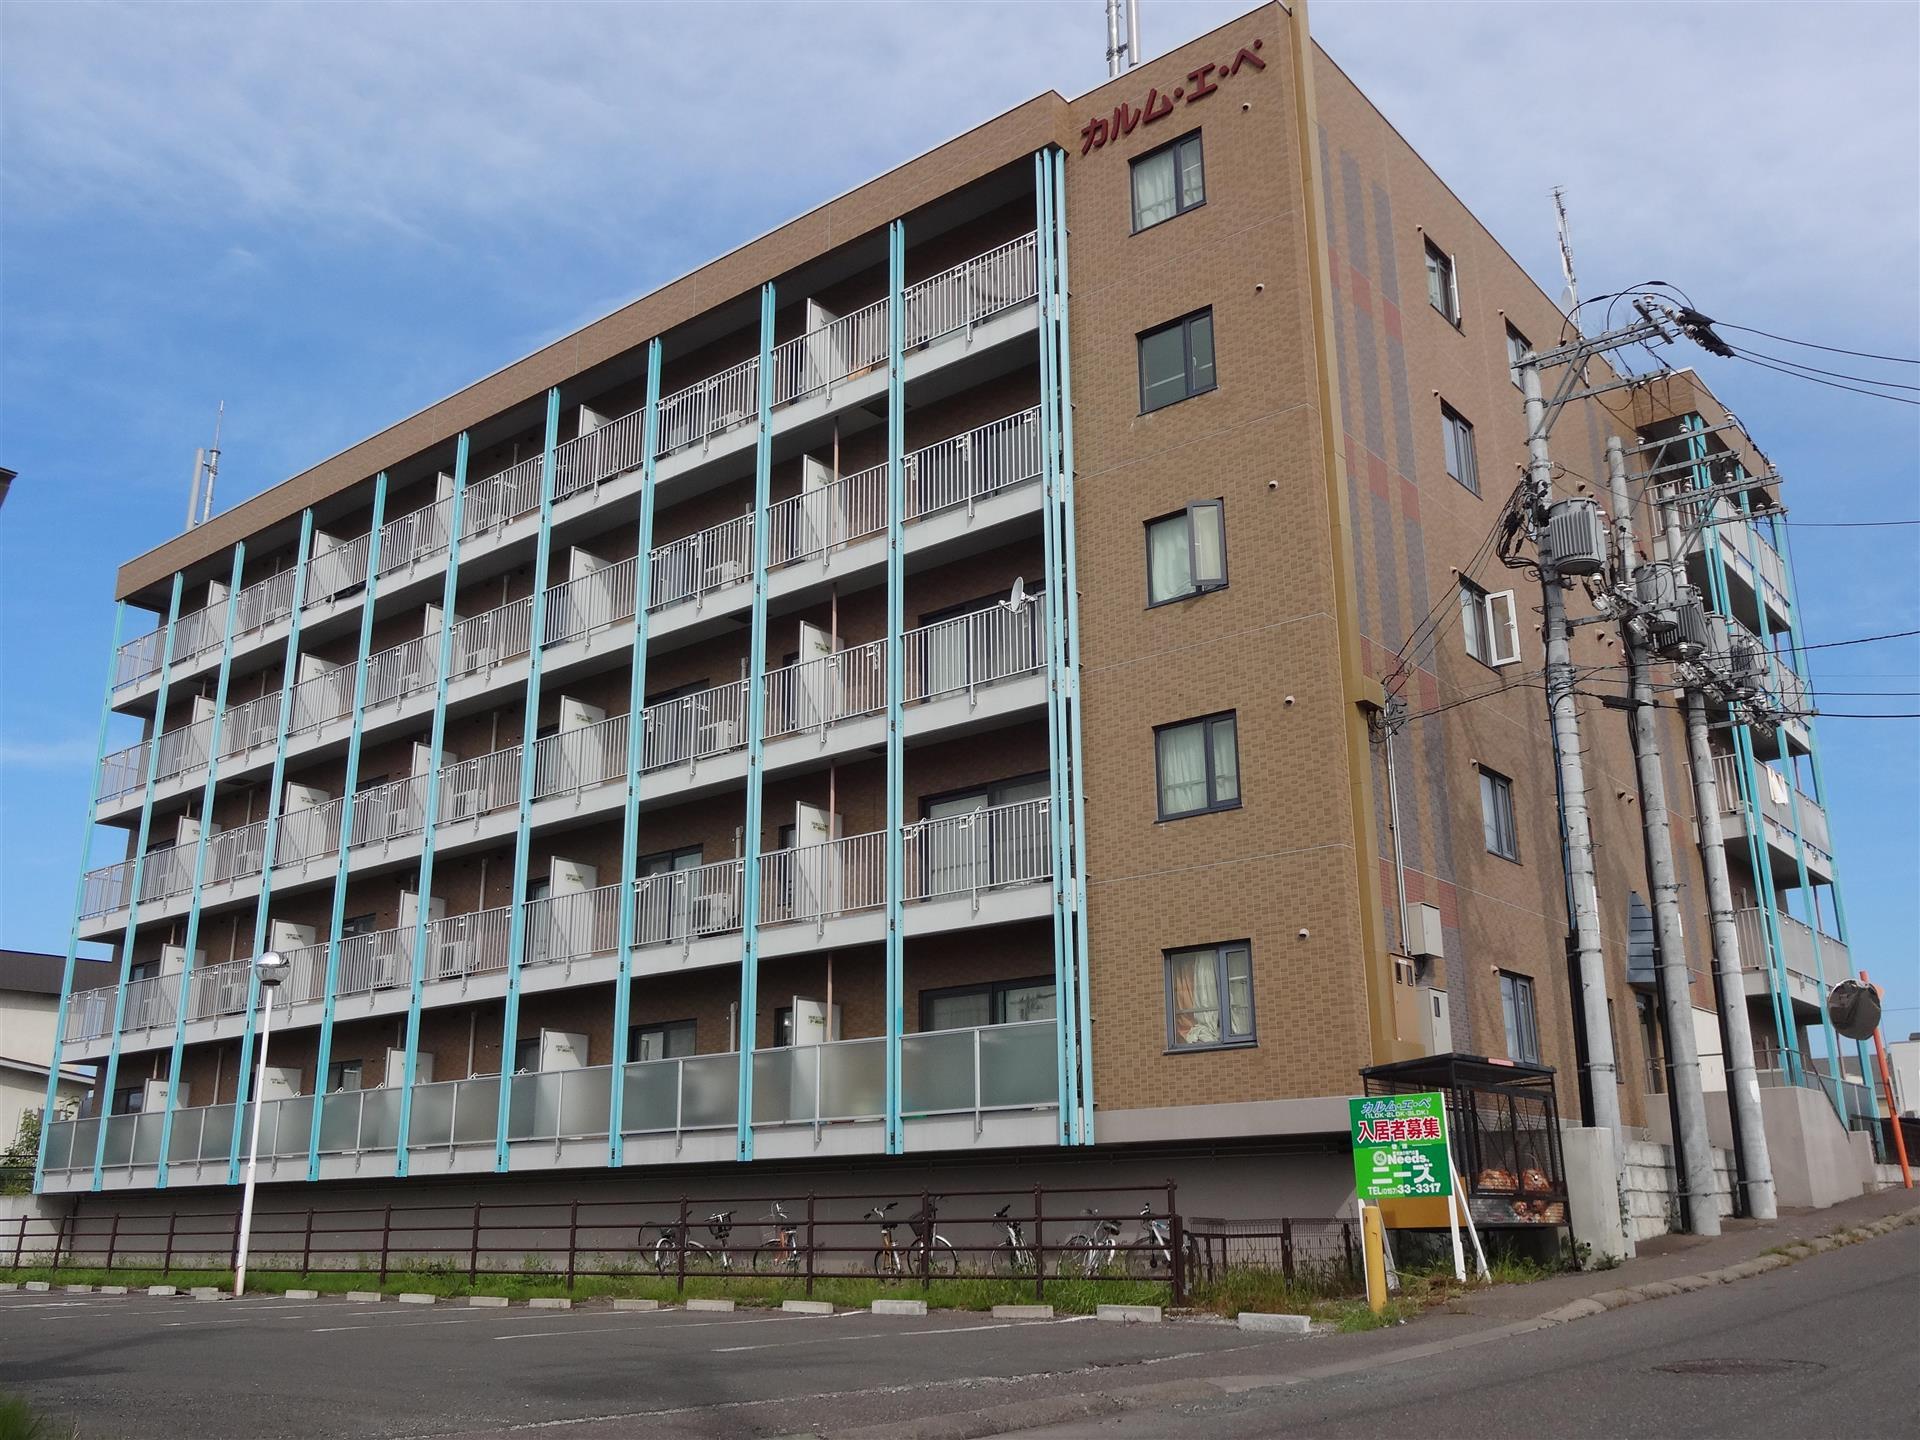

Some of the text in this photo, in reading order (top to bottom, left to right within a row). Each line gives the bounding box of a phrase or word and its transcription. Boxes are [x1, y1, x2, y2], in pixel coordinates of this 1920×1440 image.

[1357, 1116, 1441, 1143] 入居者募集
[1372, 1162, 1435, 1184] ニーズ
